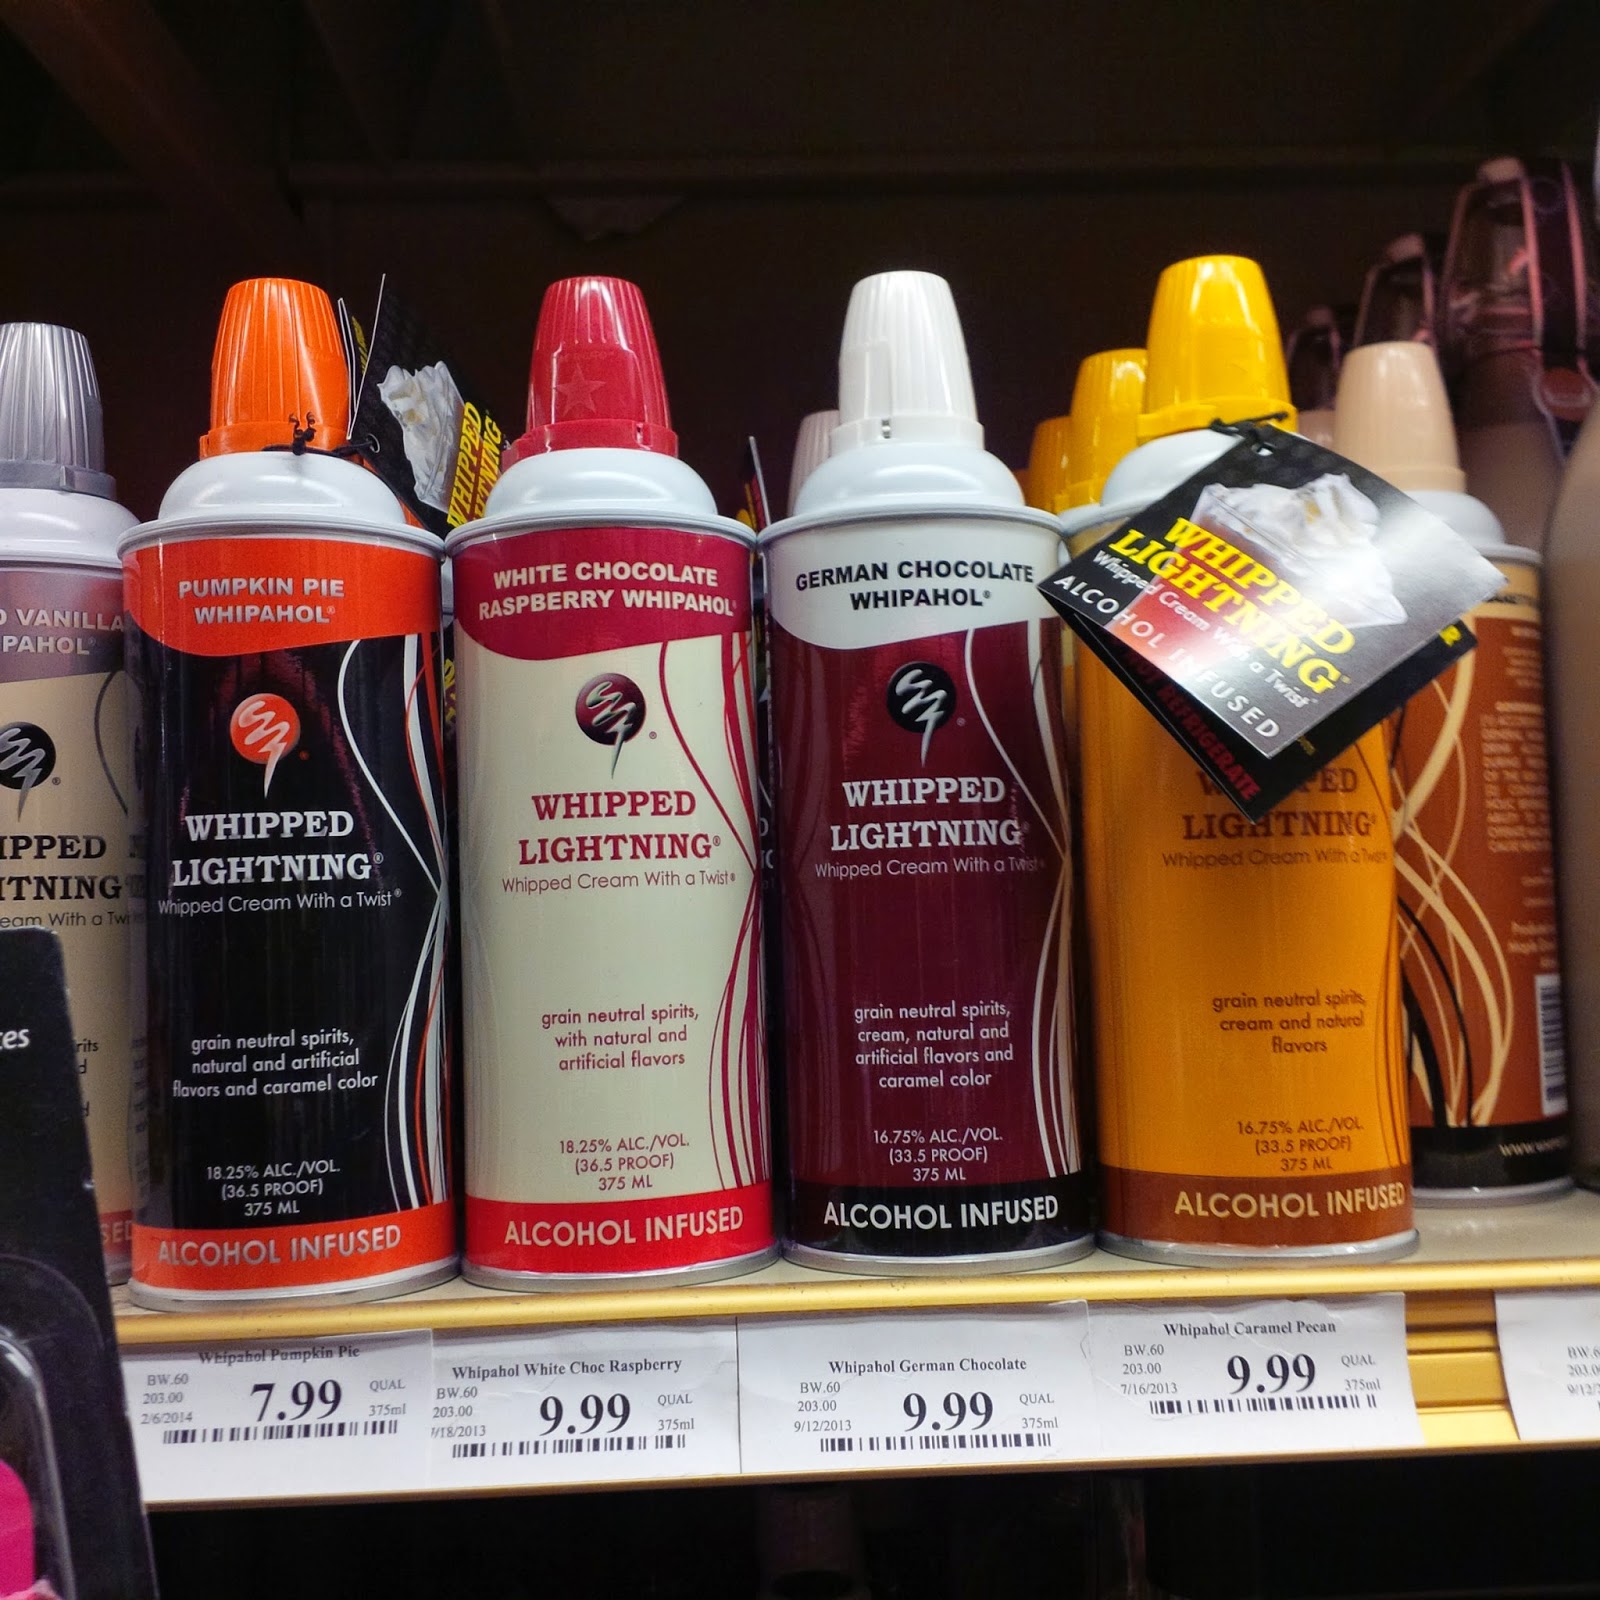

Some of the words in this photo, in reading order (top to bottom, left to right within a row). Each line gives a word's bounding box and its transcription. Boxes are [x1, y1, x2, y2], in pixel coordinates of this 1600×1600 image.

[178, 577, 294, 598] PUMPKIN
[303, 578, 345, 597] PIE
[493, 563, 567, 590] WHITE
[575, 561, 718, 588] CHOCOLATE
[795, 562, 888, 591] GERMAN
[896, 560, 1034, 583] CHOCOLATE
[1164, 517, 1355, 654] WHIPPED
[1092, 550, 1163, 596] Whipped
[1158, 591, 1210, 632] Cream
[478, 589, 614, 621] RASPBERRY
[1054, 575, 1166, 648] ALCOHOL
[1168, 648, 1281, 738] INFUSED
[842, 776, 1006, 807] WHIPPED
[531, 790, 696, 820] WHIPPED
[184, 811, 354, 841] WHIPPED
[814, 862, 882, 881] Whipped
[886, 859, 948, 875] Cream
[953, 857, 989, 873] With
[993, 860, 1006, 872] a
[1162, 850, 1243, 870] Whipped
[1249, 849, 1313, 866] Cream
[502, 874, 572, 895] Whipped
[577, 872, 639, 889] Cream
[645, 871, 680, 888] With
[685, 874, 696, 885] a
[159, 895, 223, 917] Whipped
[228, 894, 291, 912] Cream
[297, 893, 334, 909] With
[340, 896, 351, 907] a
[48, 912, 86, 926] With
[854, 1007, 894, 1024] grain
[899, 1000, 956, 1019] neutral
[961, 1000, 1011, 1019] spirits,
[1212, 993, 1257, 1015] grain
[1263, 992, 1320, 1008] neutral
[541, 1009, 582, 1029] grain
[587, 1003, 645, 1024] neutral
[651, 1003, 699, 1024] spirits,
[1220, 1018, 1272, 1031] cream
[1279, 1013, 1310, 1029] and
[1316, 1010, 1365, 1028] natural
[191, 1034, 231, 1056] grain
[236, 1029, 296, 1050] neutral
[301, 1029, 355, 1050] spirits,
[555, 1029, 587, 1047] with
[593, 1025, 651, 1047] natural
[658, 1024, 687, 1042] and
[857, 1029, 910, 1045] cream,
[916, 1022, 974, 1042] natural
[979, 1021, 1009, 1039] and
[1272, 1036, 1327, 1053] flavors
[192, 1055, 248, 1075] natural
[252, 1052, 283, 1072] and
[291, 1050, 360, 1069] artificial
[559, 1051, 624, 1071] artificial
[631, 1050, 685, 1067] flavors
[855, 1046, 918, 1065] artificial
[923, 1046, 979, 1064] flavors
[984, 1044, 1014, 1061] and
[173, 1080, 220, 1098] flavors
[225, 1077, 258, 1096] and
[263, 1074, 331, 1094] caramel
[337, 1073, 379, 1091] color
[878, 1069, 944, 1089] caramel
[949, 1068, 992, 1087] color
[873, 1130, 925, 1144] 16.75%
[929, 1126, 1003, 1146] ALC./VOL.
[1237, 1120, 1292, 1135] 16.75%
[560, 1139, 612, 1154] 18.25%
[616, 1133, 690, 1152] ALC./VOL.
[1255, 1140, 1294, 1155] (33.5
[1300, 1135, 1351, 1152] PROOF)
[575, 1158, 612, 1175] (36.5
[618, 1152, 675, 1171] PROOF)
[888, 1148, 926, 1166] (33.5
[931, 1146, 988, 1163] PROOF)
[1280, 1159, 1307, 1171] 375
[1313, 1158, 1332, 1170] ML
[206, 1164, 258, 1180] 18.25%
[264, 1159, 341, 1179] ALC./VOL.
[912, 1168, 940, 1182] 375
[944, 1167, 966, 1181] ML
[221, 1183, 259, 1201] (36.5
[264, 1178, 323, 1197] PROOF)
[598, 1177, 626, 1191] 375
[631, 1174, 653, 1188] ML
[244, 1201, 273, 1217] 375
[277, 1199, 300, 1214] ML
[1175, 1191, 1320, 1218] ALCOHOL
[1327, 1182, 1405, 1213] INFUSED
[823, 1201, 953, 1230] ALCOHOL
[960, 1195, 1059, 1228] INFUSED
[504, 1219, 637, 1247] ALCOHOL
[645, 1206, 744, 1242] INFUSED
[158, 1238, 281, 1267] ALCOHOL
[290, 1224, 401, 1262] INFUSED
[1163, 1322, 1230, 1337] Whipahol
[1234, 1321, 1292, 1335] Caramel
[1297, 1320, 1336, 1333] Pecan
[271, 1347, 333, 1363] Pumpkin
[339, 1345, 360, 1358] Pie
[452, 1364, 519, 1382] Whipahol
[524, 1361, 566, 1376] White
[570, 1360, 605, 1374] Choc
[609, 1358, 682, 1375] Raspberry
[829, 1360, 895, 1376] Whipahol
[900, 1359, 955, 1373] German
[960, 1357, 1027, 1372] Chocolate
[1122, 1363, 1162, 1375] 203.00
[1345, 1379, 1381, 1391] 375ml
[1124, 1344, 1164, 1356] BW.60
[1227, 1353, 1316, 1394] 9.99
[1341, 1355, 1376, 1366] QUAL
[147, 1373, 189, 1386] BW.60
[250, 1379, 342, 1422] 7.99
[369, 1380, 406, 1392] QUAL
[1120, 1382, 1178, 1395] 7/16/2013
[142, 1392, 183, 1404] 203.00
[368, 1404, 406, 1416] 375ml
[436, 1386, 478, 1400] BW.60
[539, 1393, 631, 1436] 9.99
[657, 1394, 693, 1406] QUAL
[798, 1400, 837, 1412] 203.00
[1021, 1417, 1058, 1429] 375ml
[800, 1381, 841, 1394] BW.60
[903, 1391, 994, 1432] 9.99
[1019, 1393, 1055, 1405] QUAL
[432, 1405, 473, 1418] 203.00
[658, 1418, 695, 1431] 375ml
[794, 1420, 852, 1433] 9/12/2013
